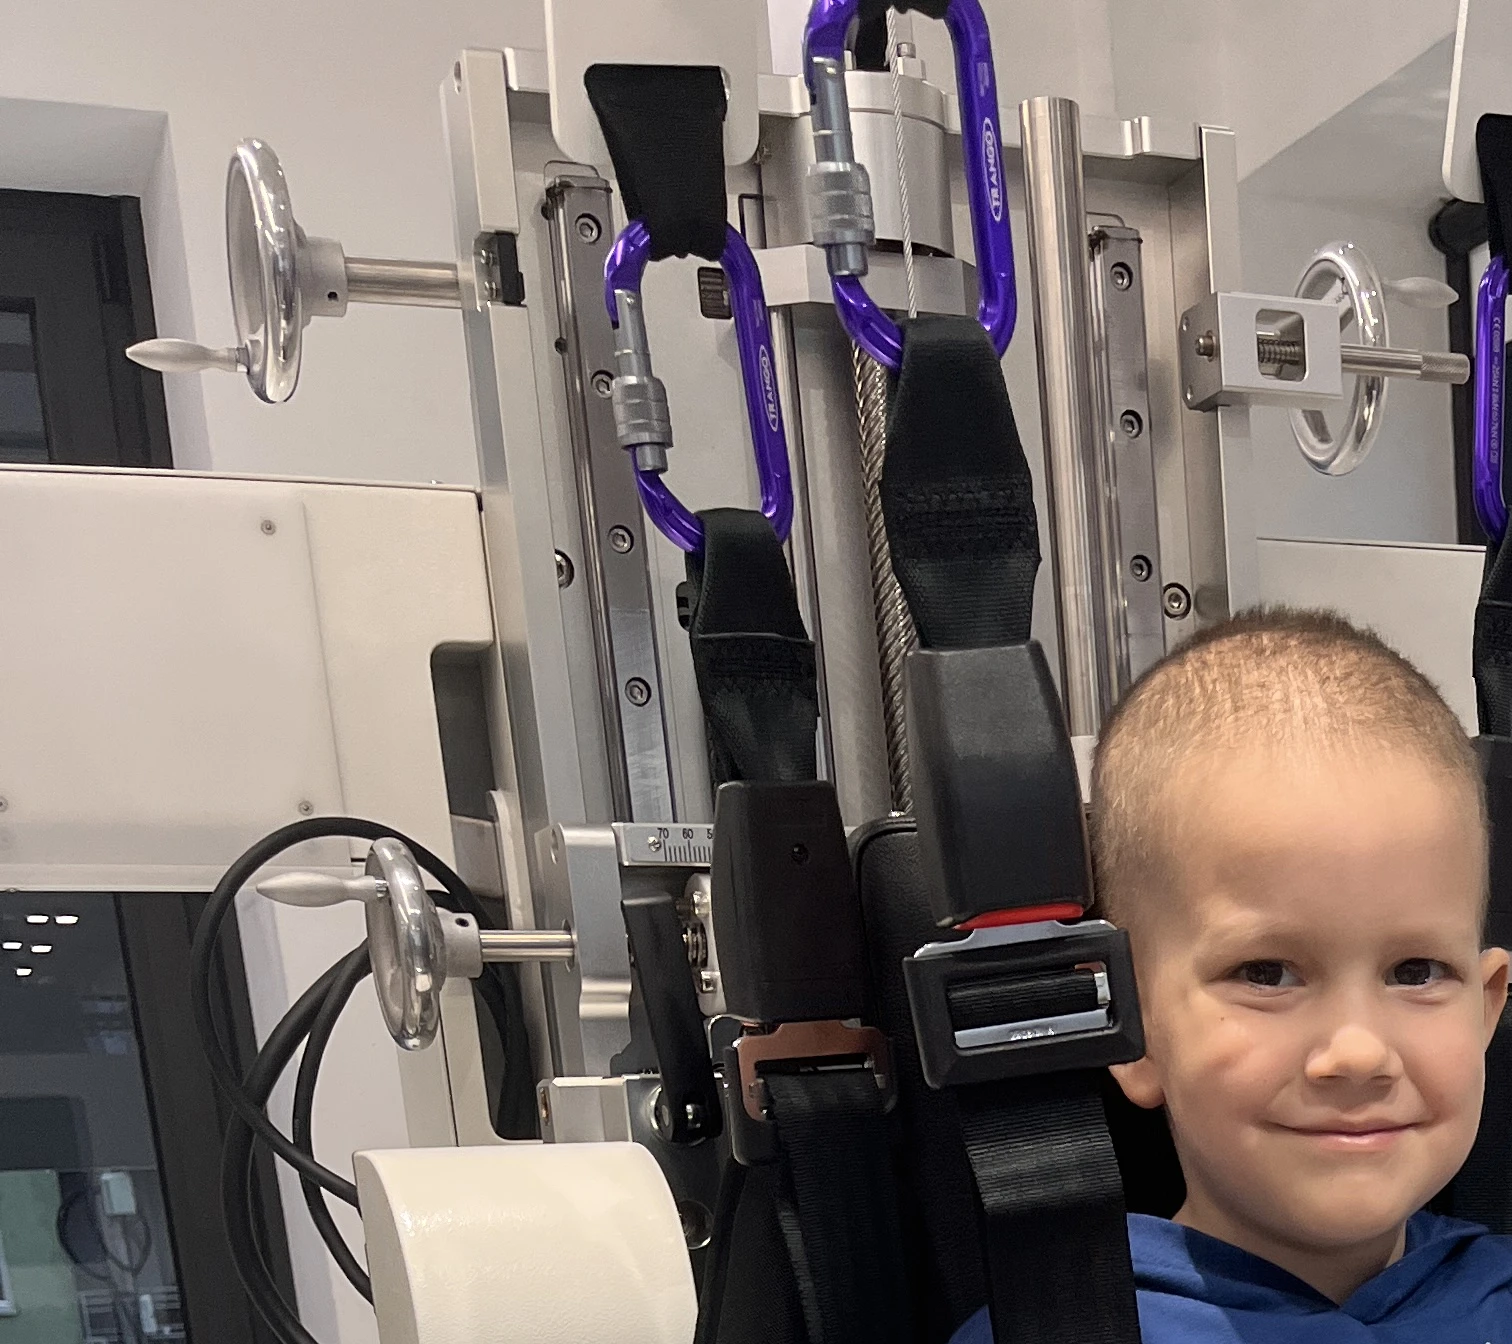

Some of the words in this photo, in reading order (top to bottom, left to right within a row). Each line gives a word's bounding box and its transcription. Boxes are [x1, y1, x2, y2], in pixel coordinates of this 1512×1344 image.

[985, 130, 1001, 209] TRANGO
[657, 828, 669, 840] 70
[683, 828, 694, 840] 60
